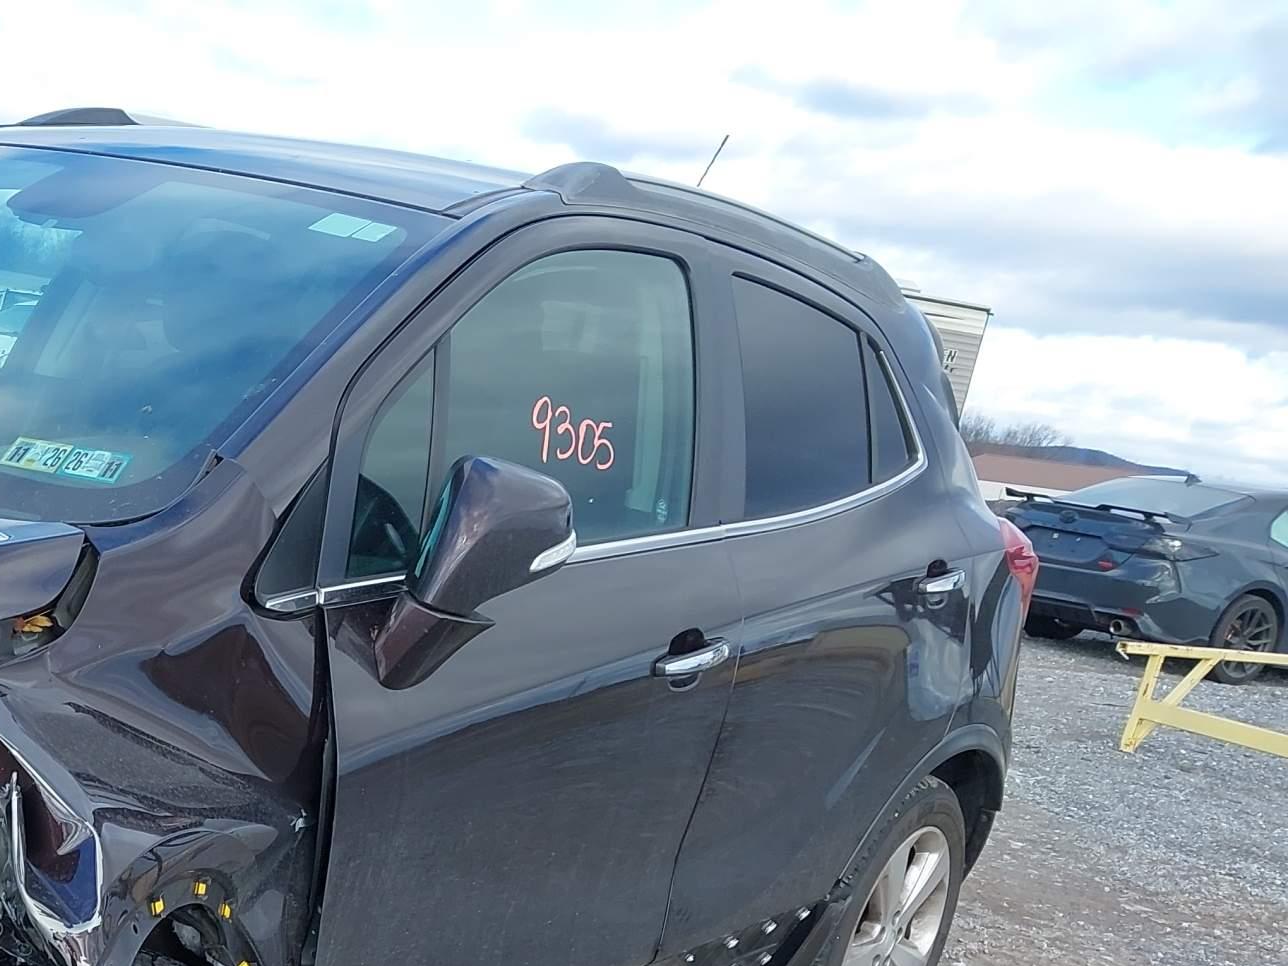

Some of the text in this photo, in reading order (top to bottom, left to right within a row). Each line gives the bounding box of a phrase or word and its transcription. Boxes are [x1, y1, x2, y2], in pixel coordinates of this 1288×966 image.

[532, 395, 615, 471] 9305
[64, 451, 123, 479] 26 11
